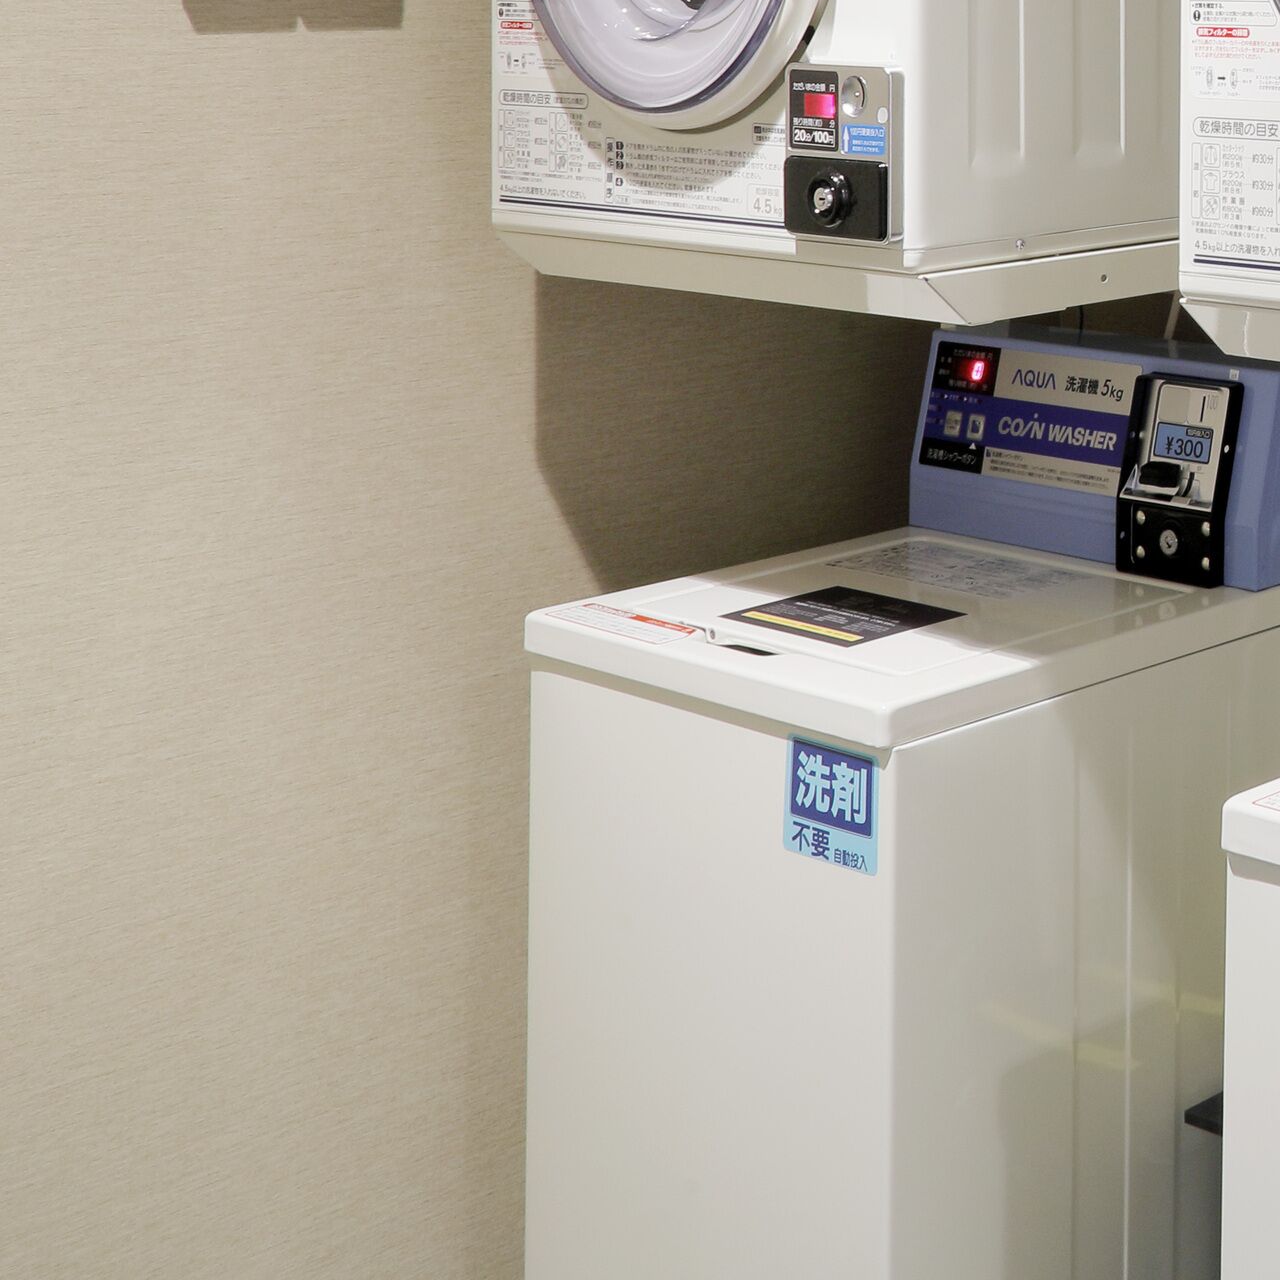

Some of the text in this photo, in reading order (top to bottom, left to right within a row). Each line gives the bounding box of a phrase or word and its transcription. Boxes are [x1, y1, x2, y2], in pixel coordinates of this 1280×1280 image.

[1199, 120, 1279, 138] 乾燥時間の目安
[1012, 369, 1056, 390] AQUA
[1065, 376, 1123, 402] 洗濯機 5kg
[1048, 424, 1117, 451] WASHER
[1165, 436, 1203, 458] ¥300
[795, 751, 867, 824] 洗剤
[792, 821, 868, 872] 不要 自動投入
